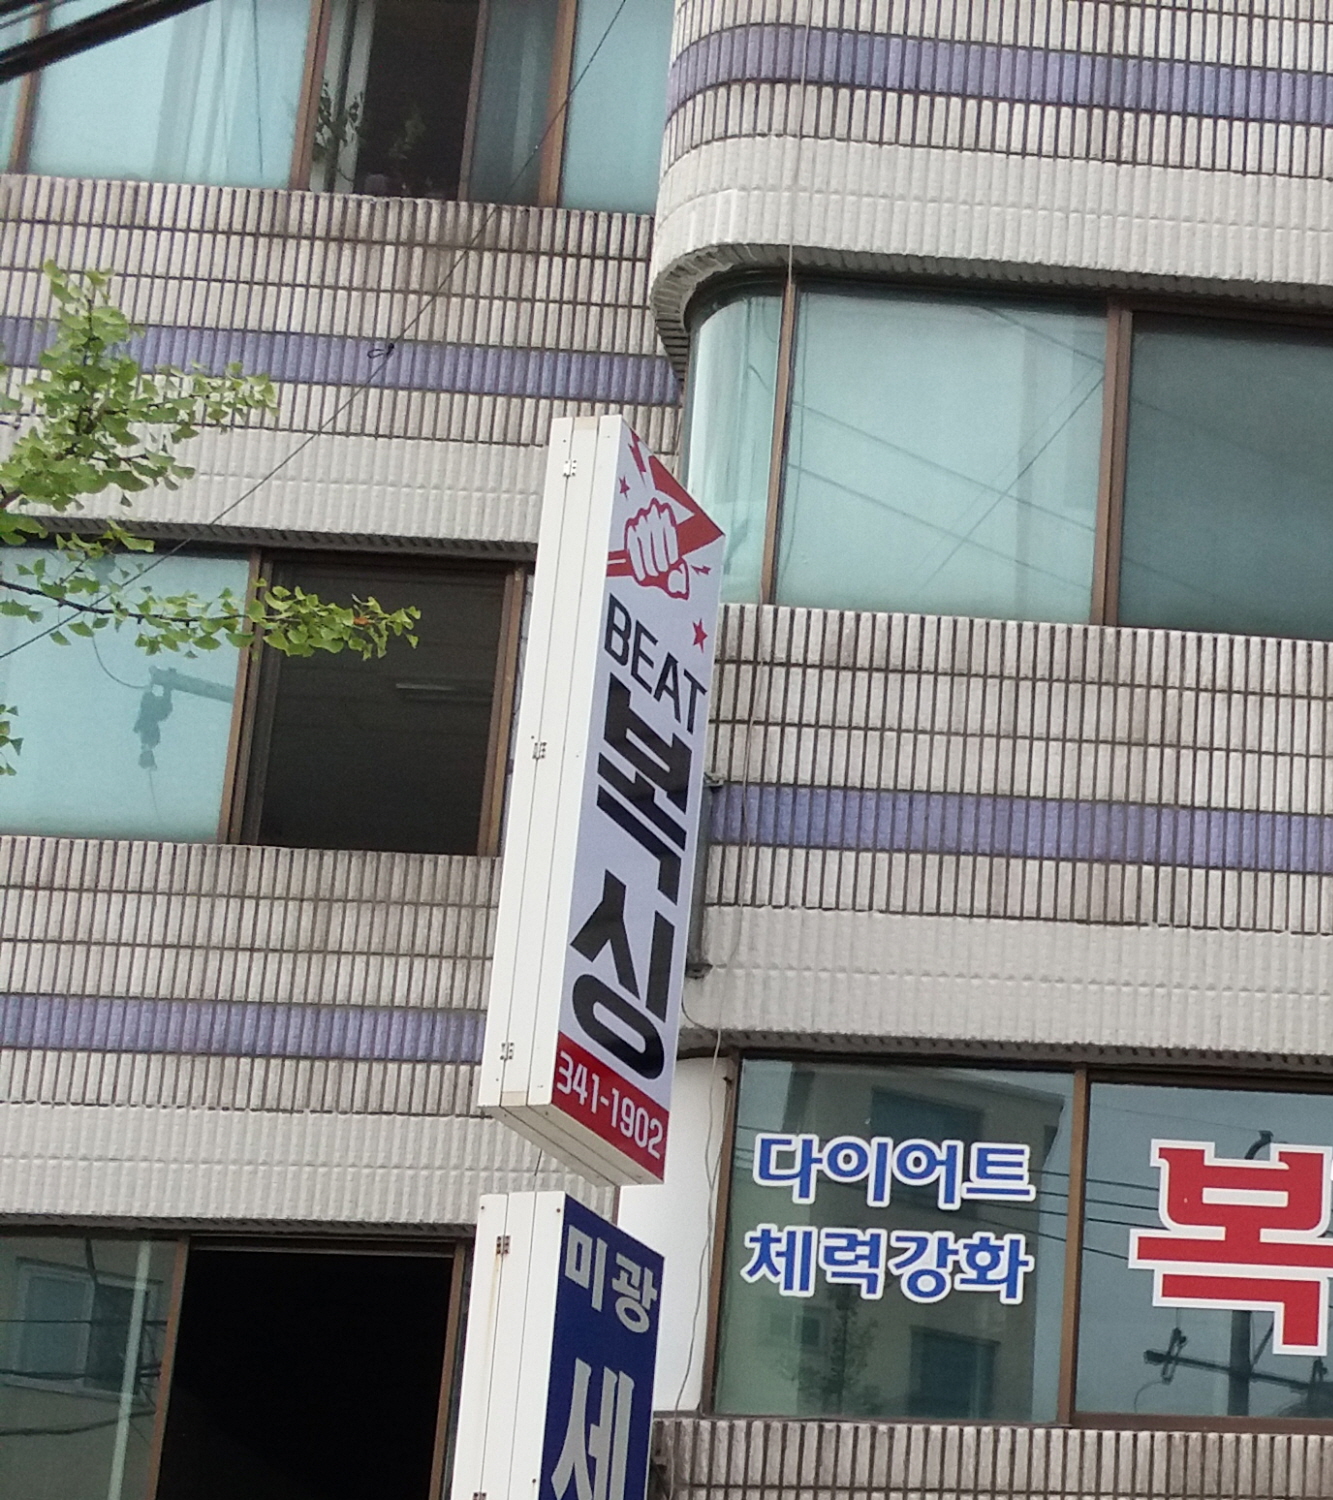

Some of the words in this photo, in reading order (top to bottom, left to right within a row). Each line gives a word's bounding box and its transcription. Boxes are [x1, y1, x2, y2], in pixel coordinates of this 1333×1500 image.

[603, 594, 708, 735] BEAT
[569, 672, 694, 1081] 복싱
[556, 1049, 665, 1160] 341-1902
[753, 1133, 1036, 1210] 다이어트
[564, 1223, 658, 1334] 미광
[741, 1224, 1035, 1306] 체력강화
